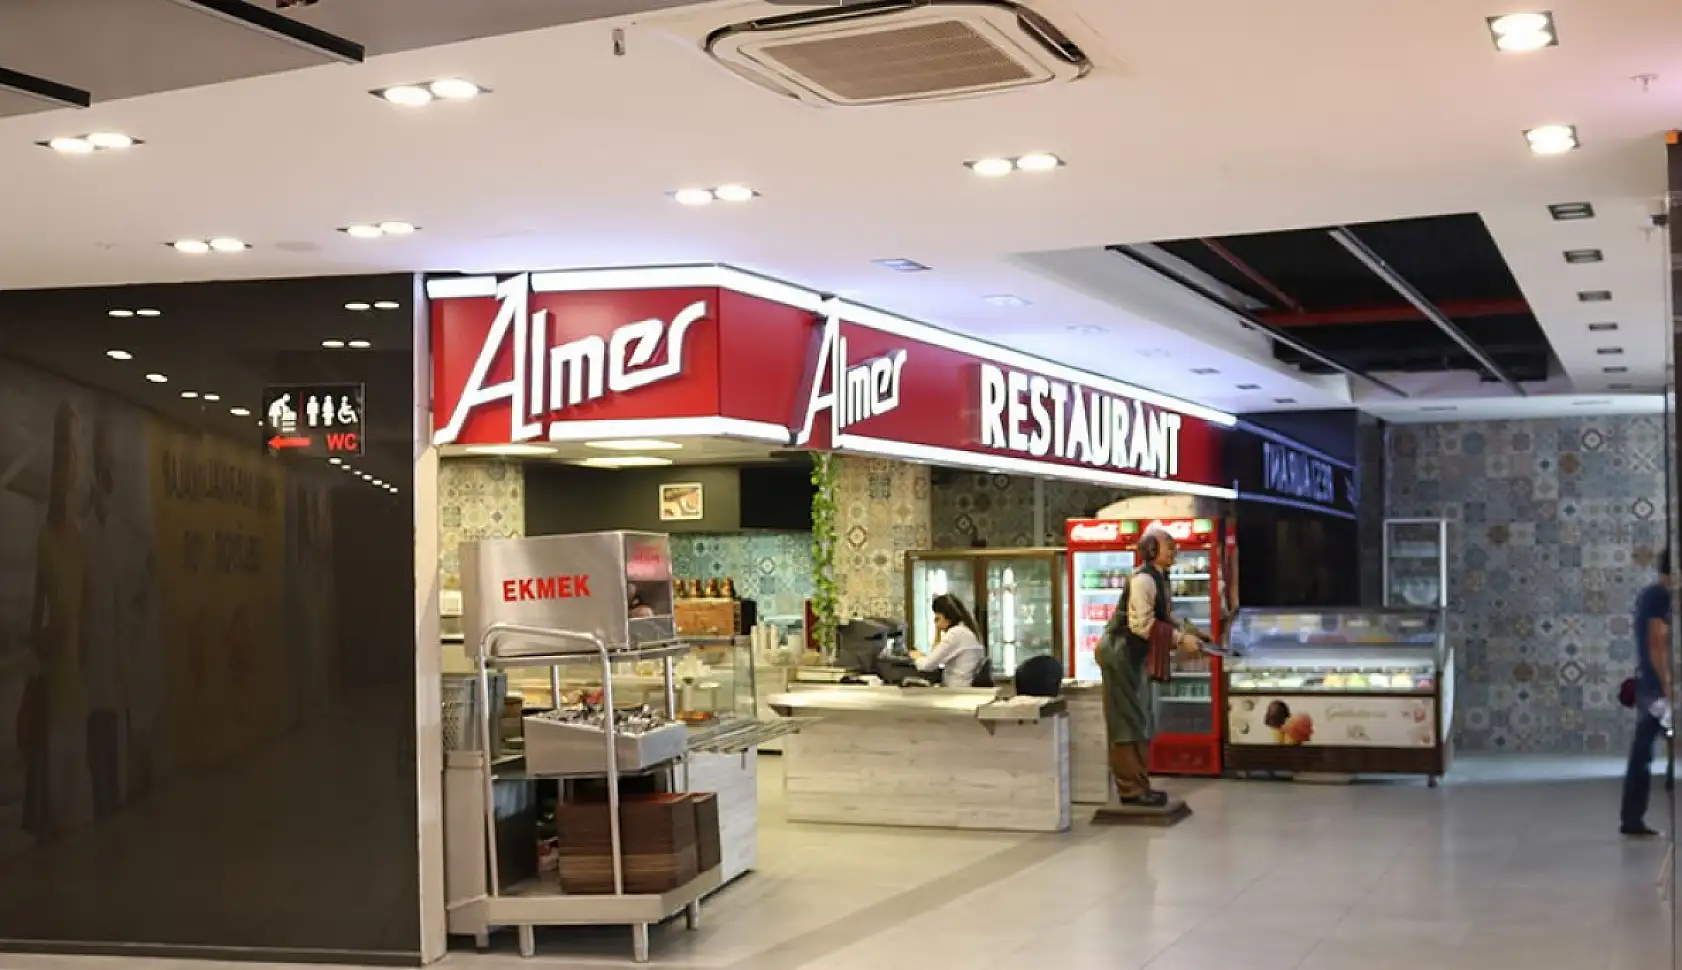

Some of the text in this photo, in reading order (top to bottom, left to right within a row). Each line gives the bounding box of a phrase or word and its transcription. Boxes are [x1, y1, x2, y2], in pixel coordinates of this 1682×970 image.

[434, 272, 706, 444] Almer
[795, 296, 907, 449] Almer
[980, 362, 1182, 478] RESTAURANT
[327, 433, 357, 451] WC
[502, 574, 591, 602] EKMEK
